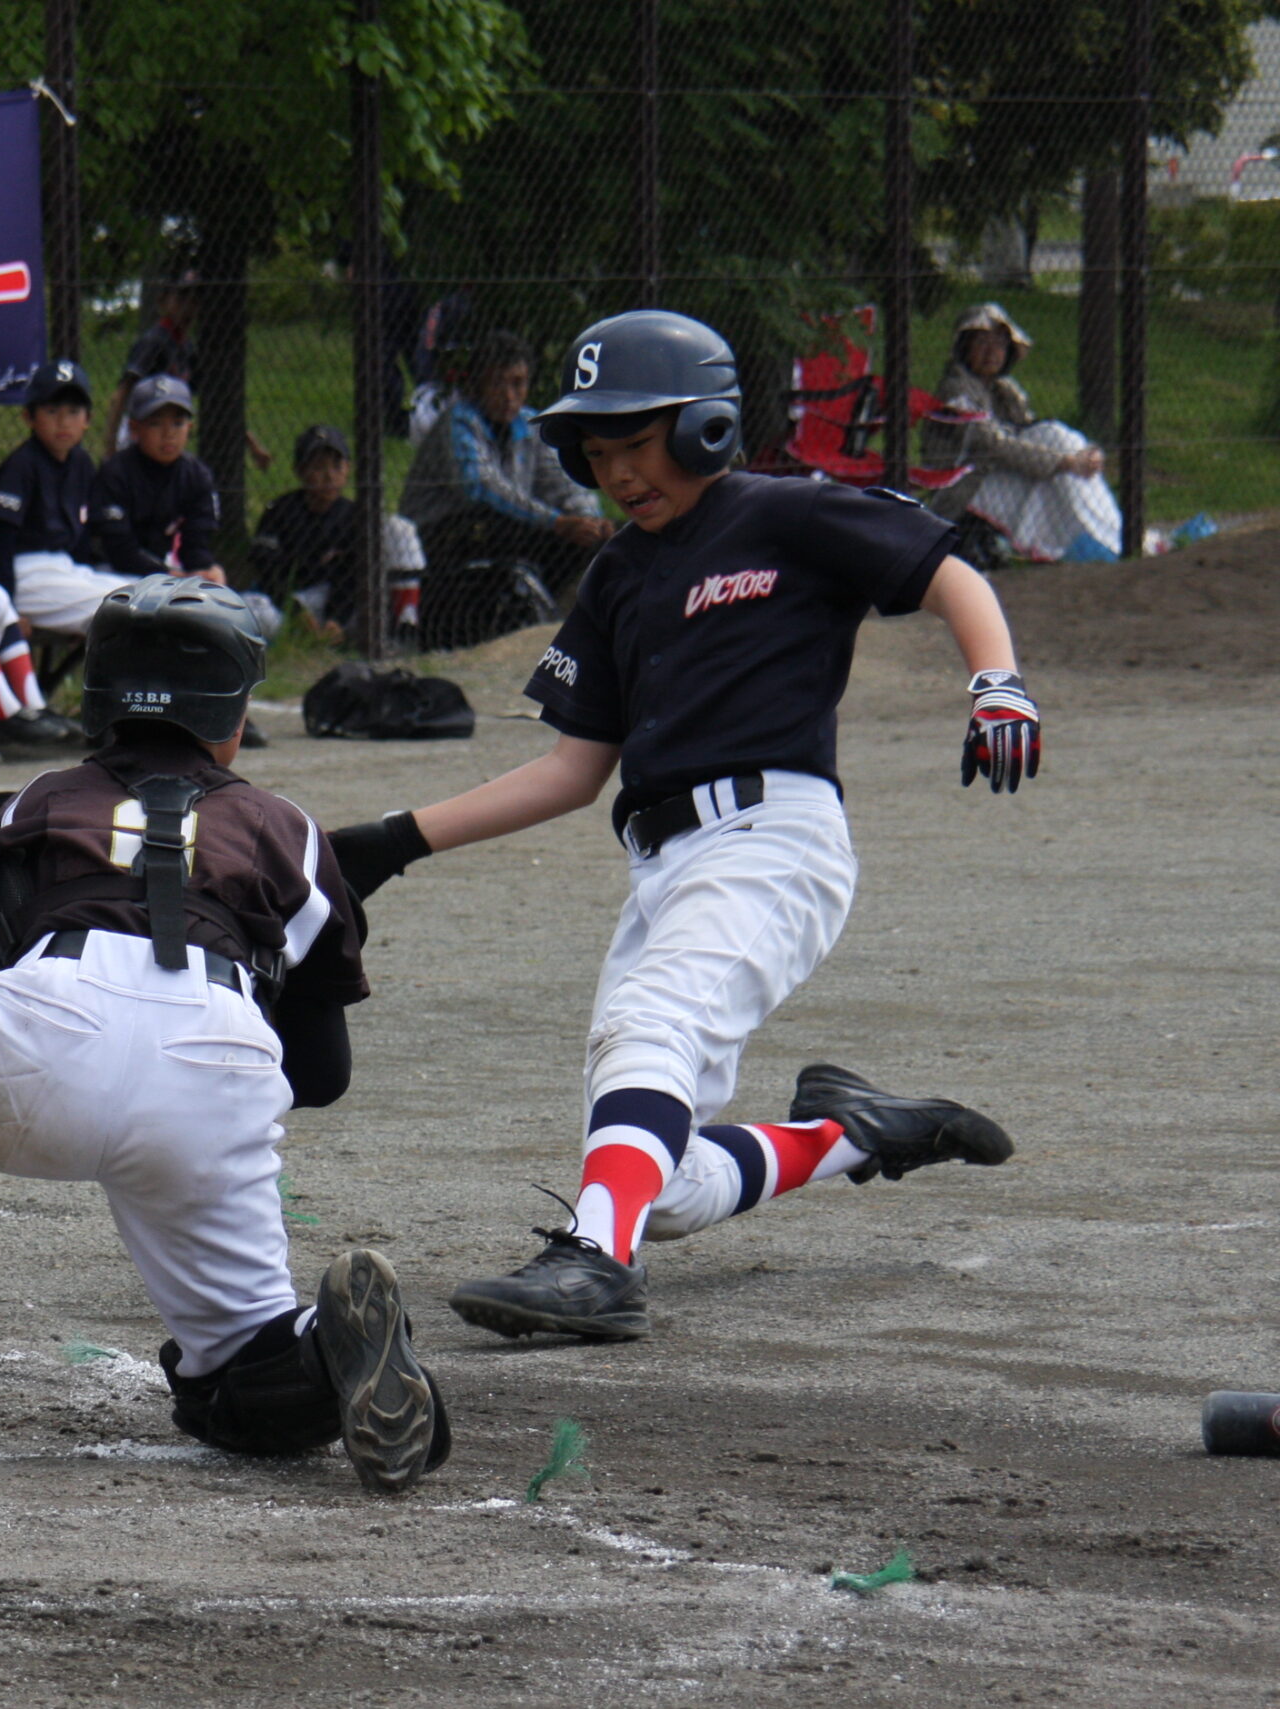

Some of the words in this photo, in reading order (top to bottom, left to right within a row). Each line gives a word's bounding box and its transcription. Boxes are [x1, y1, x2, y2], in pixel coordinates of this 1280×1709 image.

[56, 360, 74, 382] S
[574, 342, 602, 390] S
[684, 569, 779, 619] VICTORY
